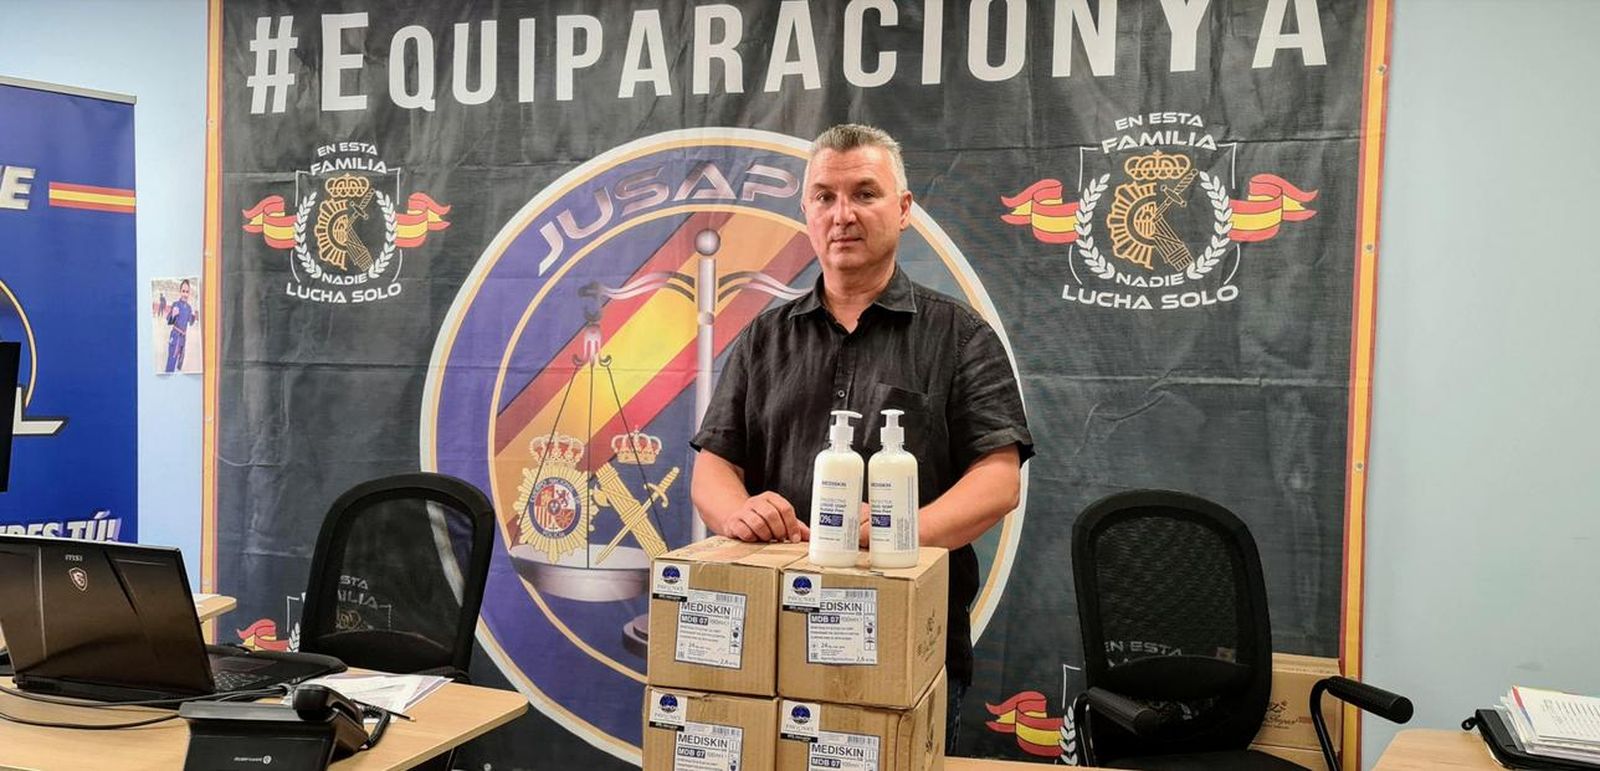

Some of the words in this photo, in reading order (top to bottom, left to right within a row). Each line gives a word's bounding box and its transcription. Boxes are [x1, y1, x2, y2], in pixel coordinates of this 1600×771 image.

[1114, 114, 1143, 131] EN
[1149, 112, 1204, 128] ESTA
[317, 144, 336, 157] EN
[340, 142, 378, 156] ESTA
[1102, 130, 1218, 154] FAMILIA
[310, 157, 387, 176] FAMILIA
[0, 165, 36, 210] E
[322, 272, 368, 286] NADIE
[1115, 272, 1186, 288] NADIE
[286, 282, 347, 304] LUCHA
[351, 282, 402, 303] SOLO
[1062, 284, 1154, 310] LUCHA
[1161, 284, 1240, 310] SOLO
[681, 602, 731, 615] MEDISKIN
[820, 602, 862, 612] EDISKIN
[678, 734, 728, 748] MEDISKIN
[811, 744, 864, 758] MEDISKIN
